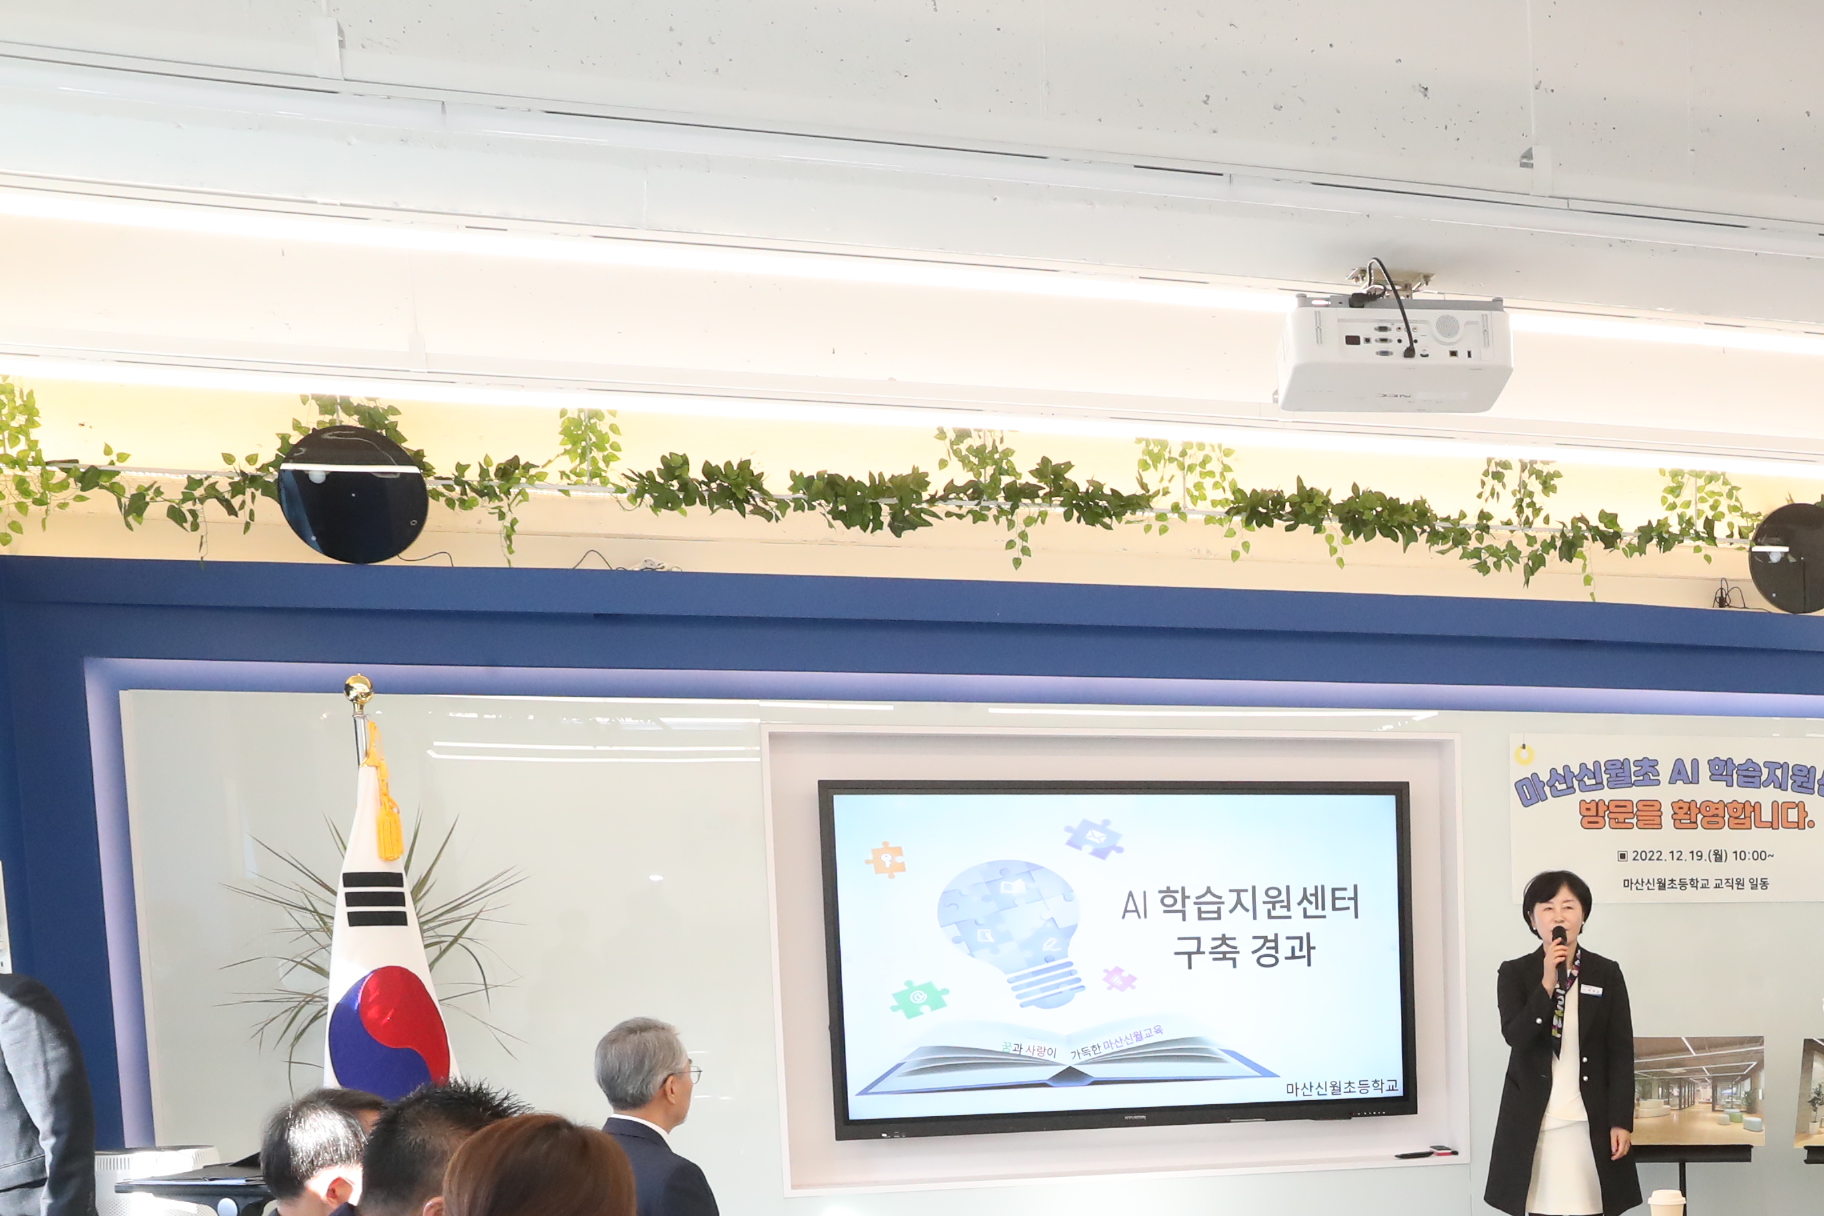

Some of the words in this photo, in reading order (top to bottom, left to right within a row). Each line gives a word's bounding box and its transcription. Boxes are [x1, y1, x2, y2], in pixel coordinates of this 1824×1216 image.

[1514, 757, 1661, 808] 마산신월초
[1668, 758, 1699, 785] AI
[1579, 799, 1663, 830] 방문을
[1671, 799, 1816, 830] 환영합니다.
[1632, 849, 1728, 863] 2022.12.19.(월)
[1623, 877, 1710, 891] 마산신월초등학교
[1713, 877, 1745, 890] 교직원
[1748, 877, 1770, 890] 일동
[1122, 890, 1147, 920] AI
[1158, 884, 1359, 921] 학습지원센터
[1174, 933, 1240, 970] 구축
[1251, 932, 1316, 968] 경과
[1001, 1041, 1023, 1056] 꿈과
[1025, 1045, 1057, 1058] 사랑이
[1070, 1043, 1102, 1060] 가득한
[1102, 1024, 1164, 1051] 마산신월교육
[1286, 1079, 1399, 1097] 마산신월초등학교
